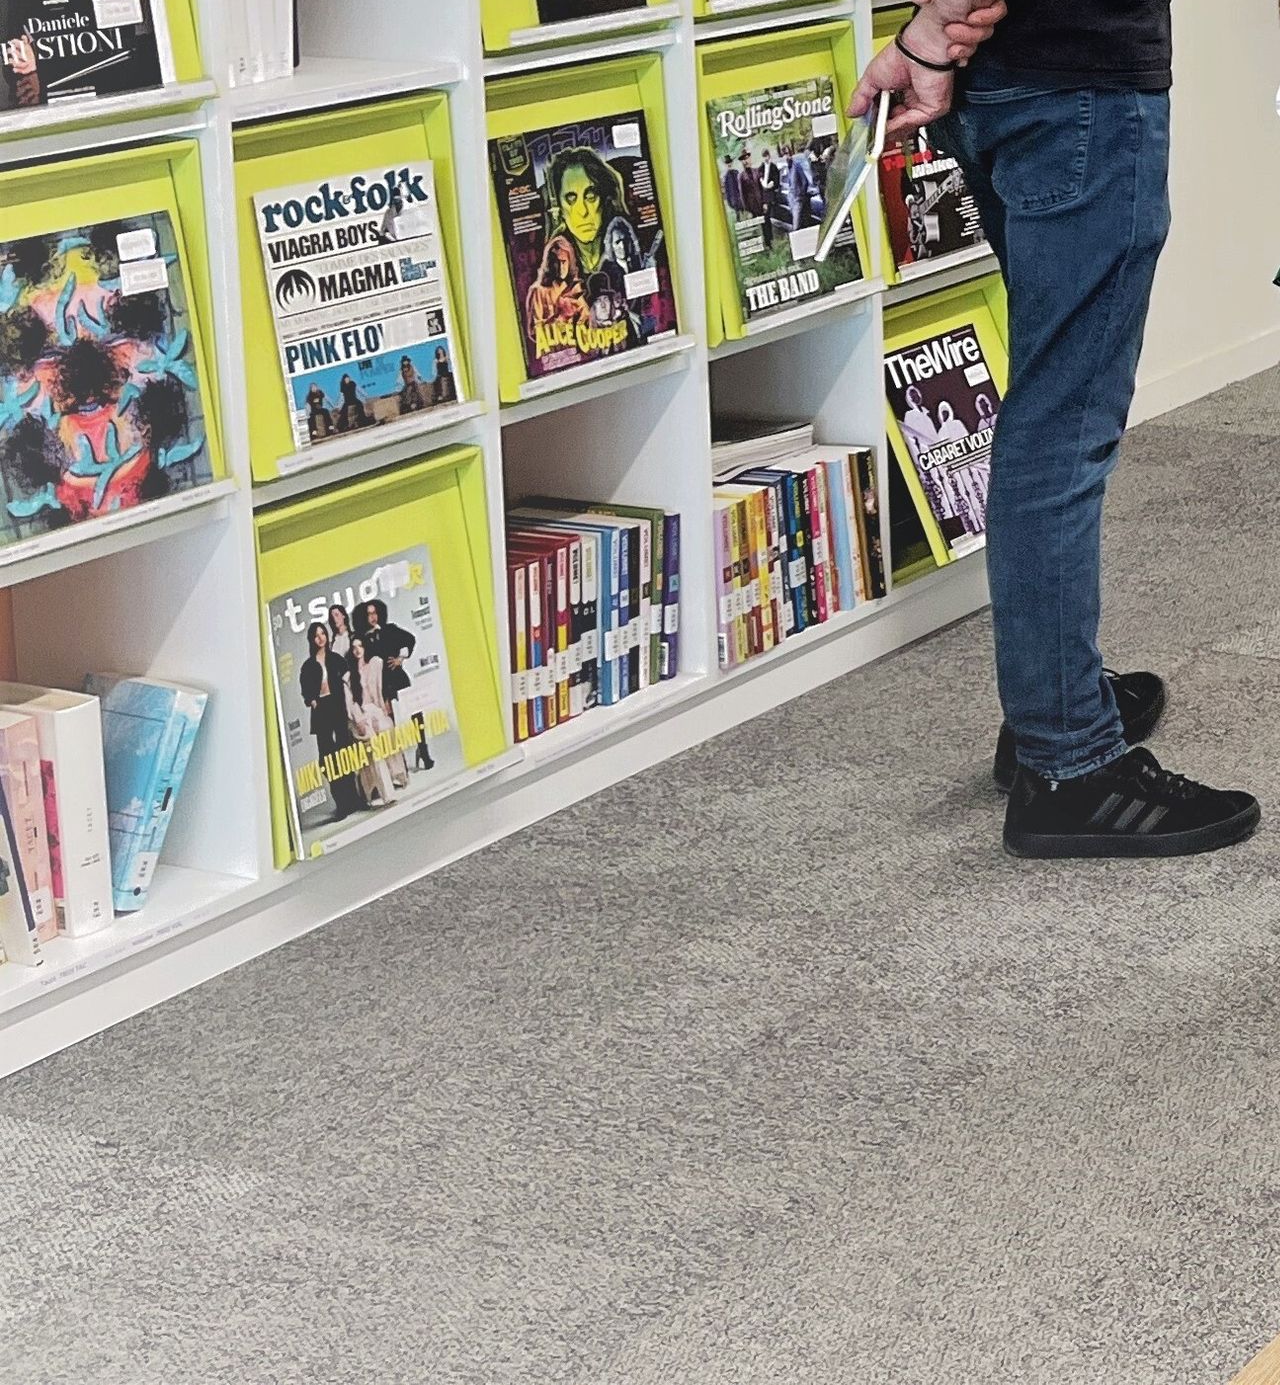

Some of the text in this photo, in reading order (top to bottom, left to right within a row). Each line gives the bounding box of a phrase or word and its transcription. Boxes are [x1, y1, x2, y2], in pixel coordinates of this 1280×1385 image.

[268, 220, 380, 264] VIAGRA BOYS
[318, 261, 400, 303] MAGMA
[746, 268, 820, 312] THE BAND
[285, 322, 384, 374] PINK FLO
[534, 318, 577, 360] ALICE
[576, 319, 629, 354] COOPER
[918, 436, 967, 471] CABARET
